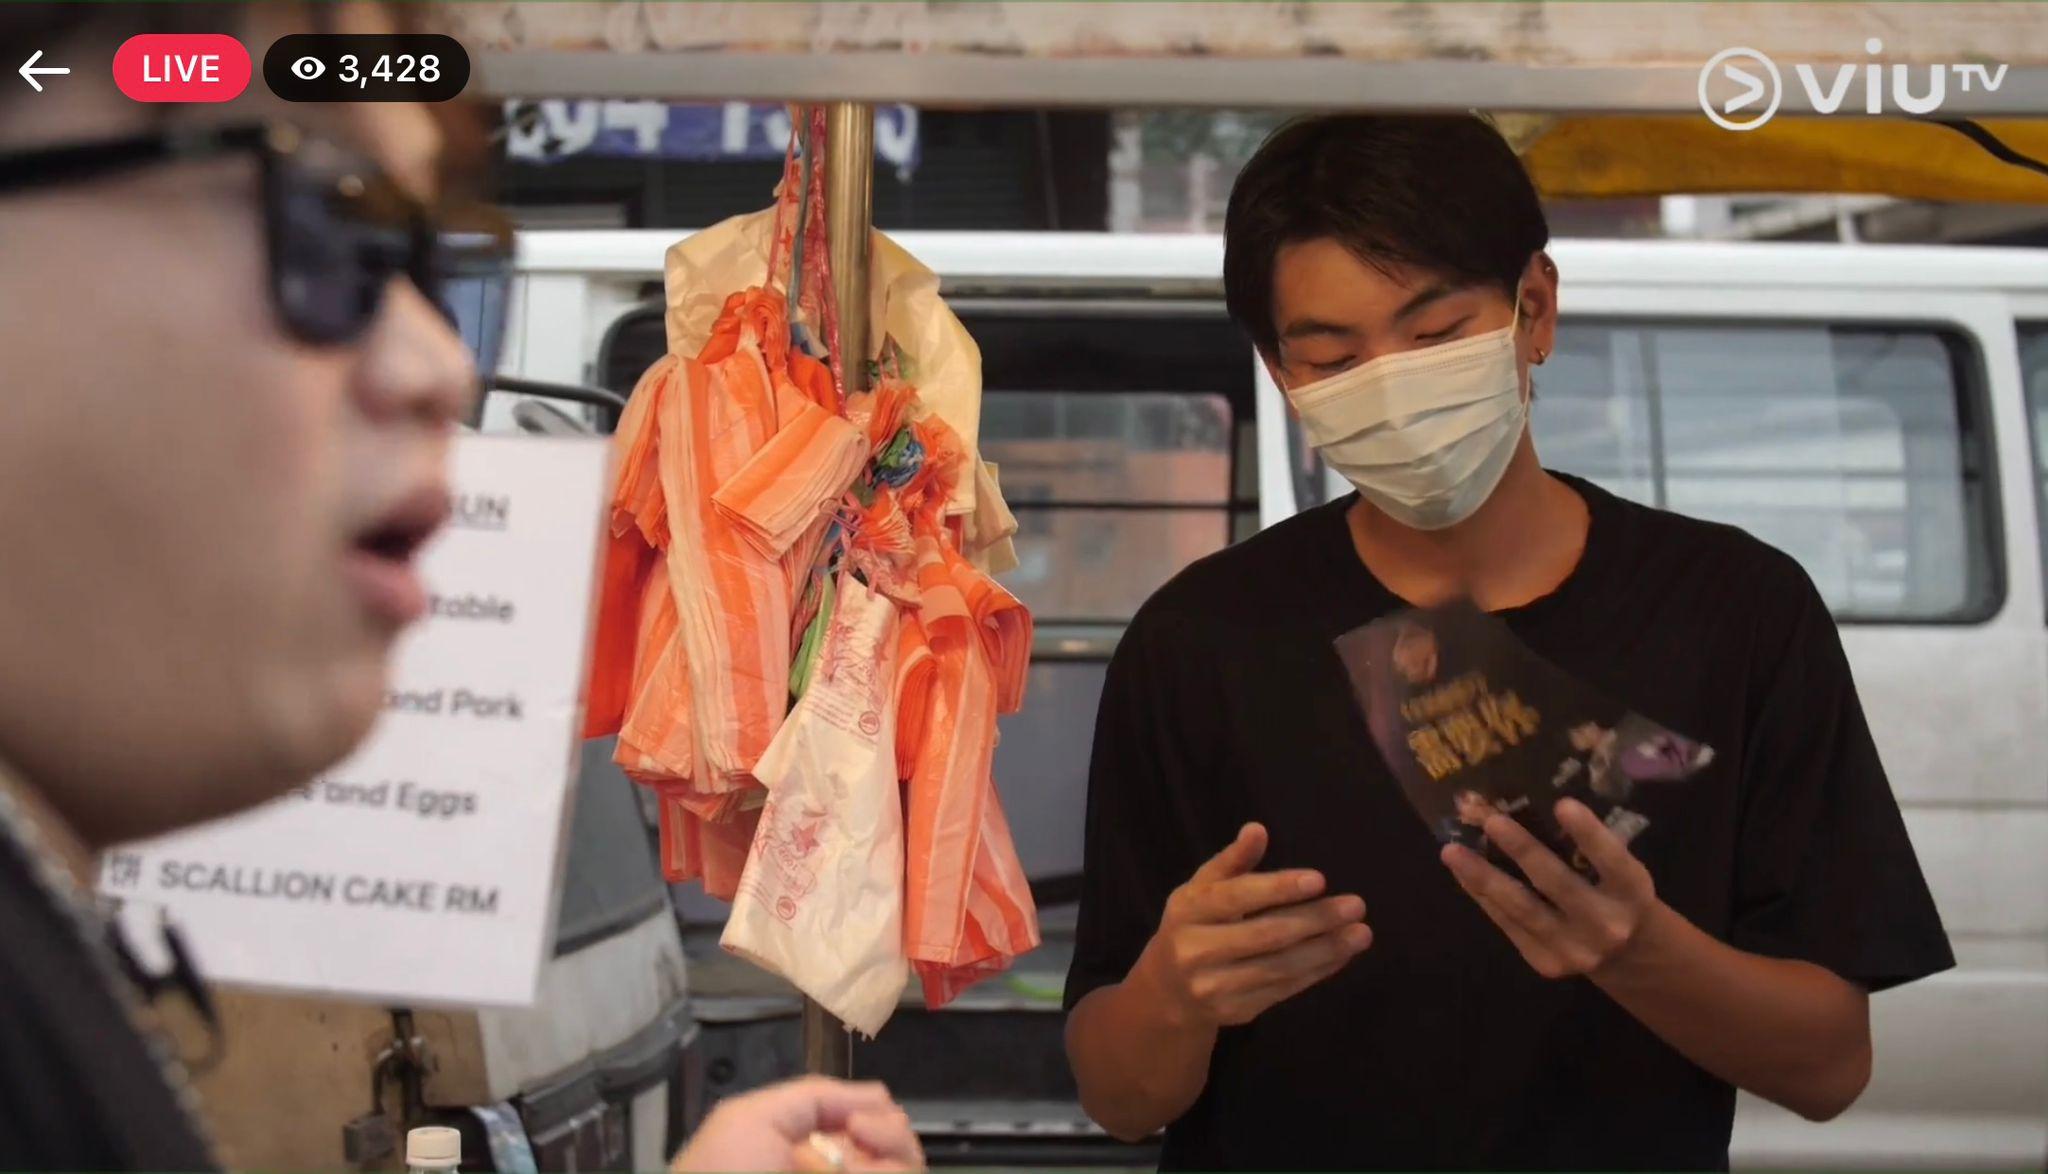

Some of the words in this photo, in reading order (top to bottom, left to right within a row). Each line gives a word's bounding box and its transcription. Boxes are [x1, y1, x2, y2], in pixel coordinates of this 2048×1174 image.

[446, 491, 511, 521] UN
[428, 592, 516, 623] table
[450, 689, 523, 720] Pork
[323, 780, 389, 807] and
[394, 782, 478, 819] Eggs
[158, 859, 336, 904] SCALLION
[343, 873, 439, 913] CAKE
[444, 881, 500, 916] RM
